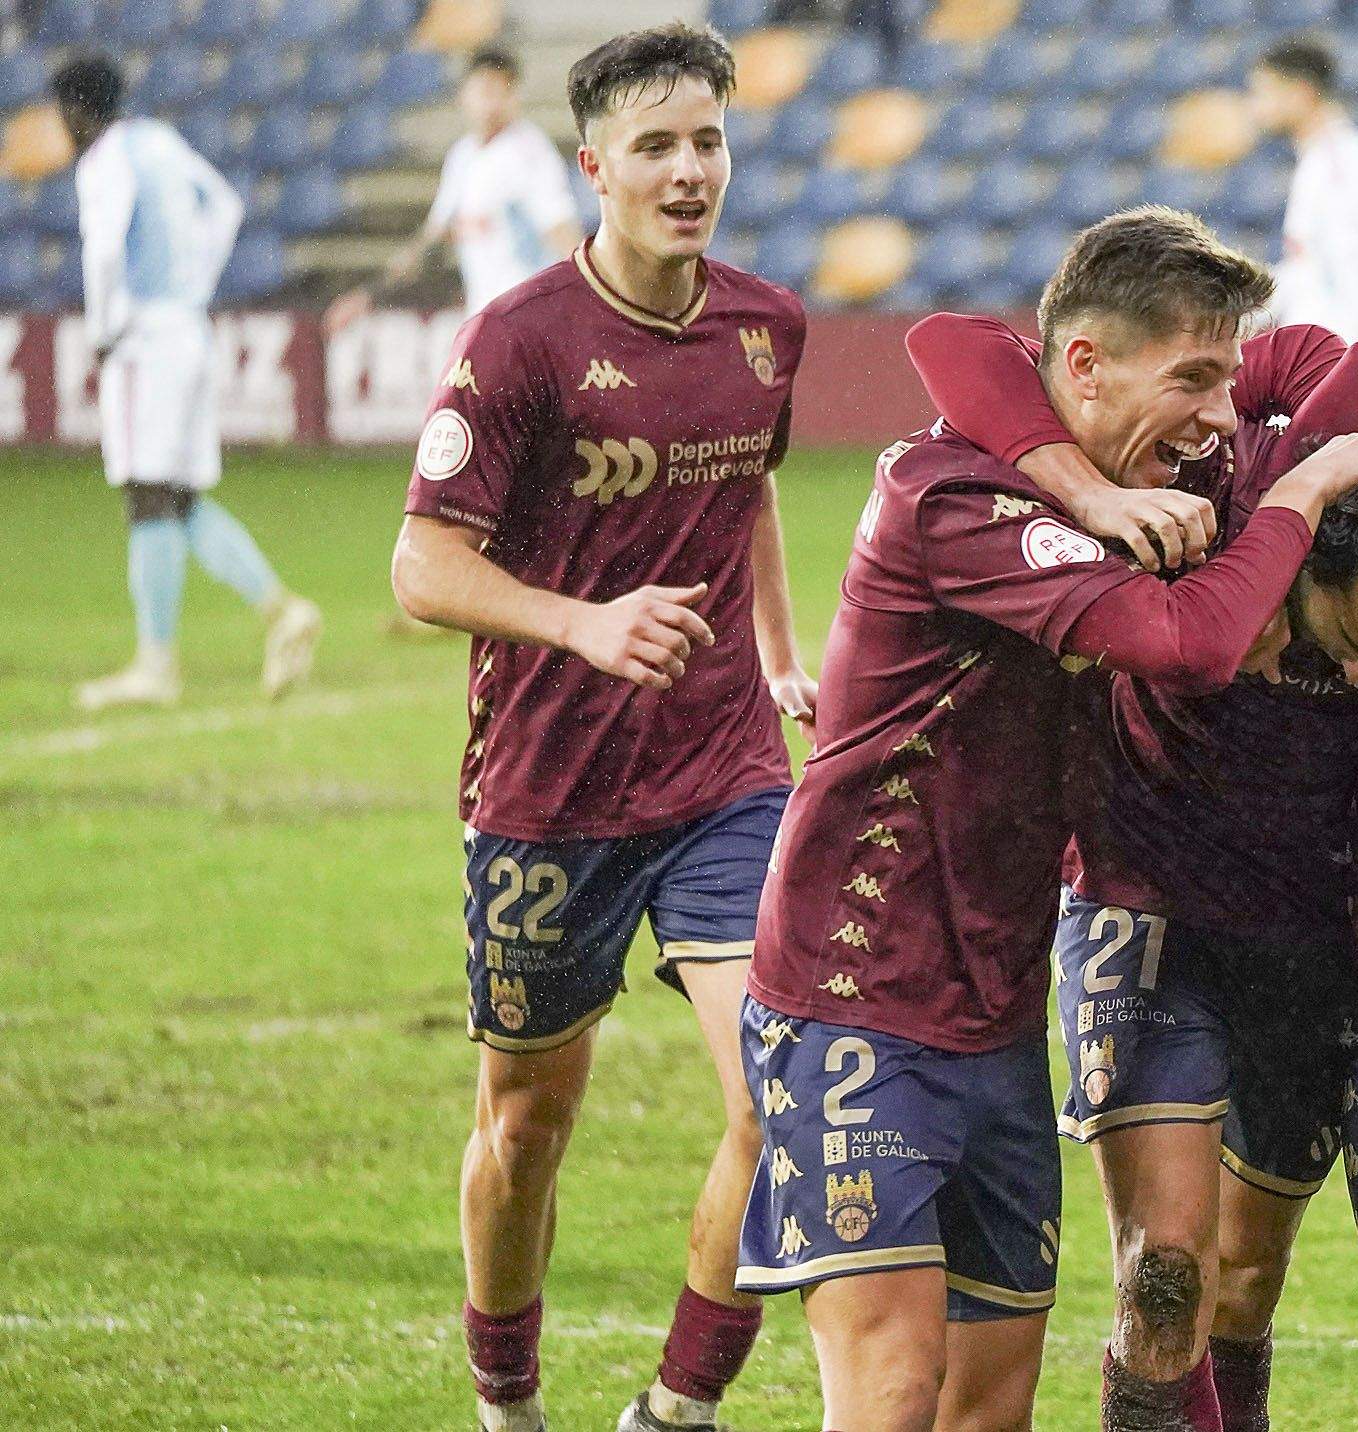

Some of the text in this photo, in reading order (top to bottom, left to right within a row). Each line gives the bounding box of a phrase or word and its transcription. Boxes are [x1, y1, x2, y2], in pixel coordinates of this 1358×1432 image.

[669, 427, 774, 465] Deputació
[667, 455, 766, 487] Ponteved
[487, 856, 569, 943] 22
[1083, 906, 1167, 995] 21
[1096, 1009, 1177, 1026] DE GALICIA
[1098, 996, 1146, 1012] XUNTA
[823, 1036, 876, 1126] 2
[851, 1130, 905, 1144] XUNTA
[851, 1144, 876, 1158] DE
